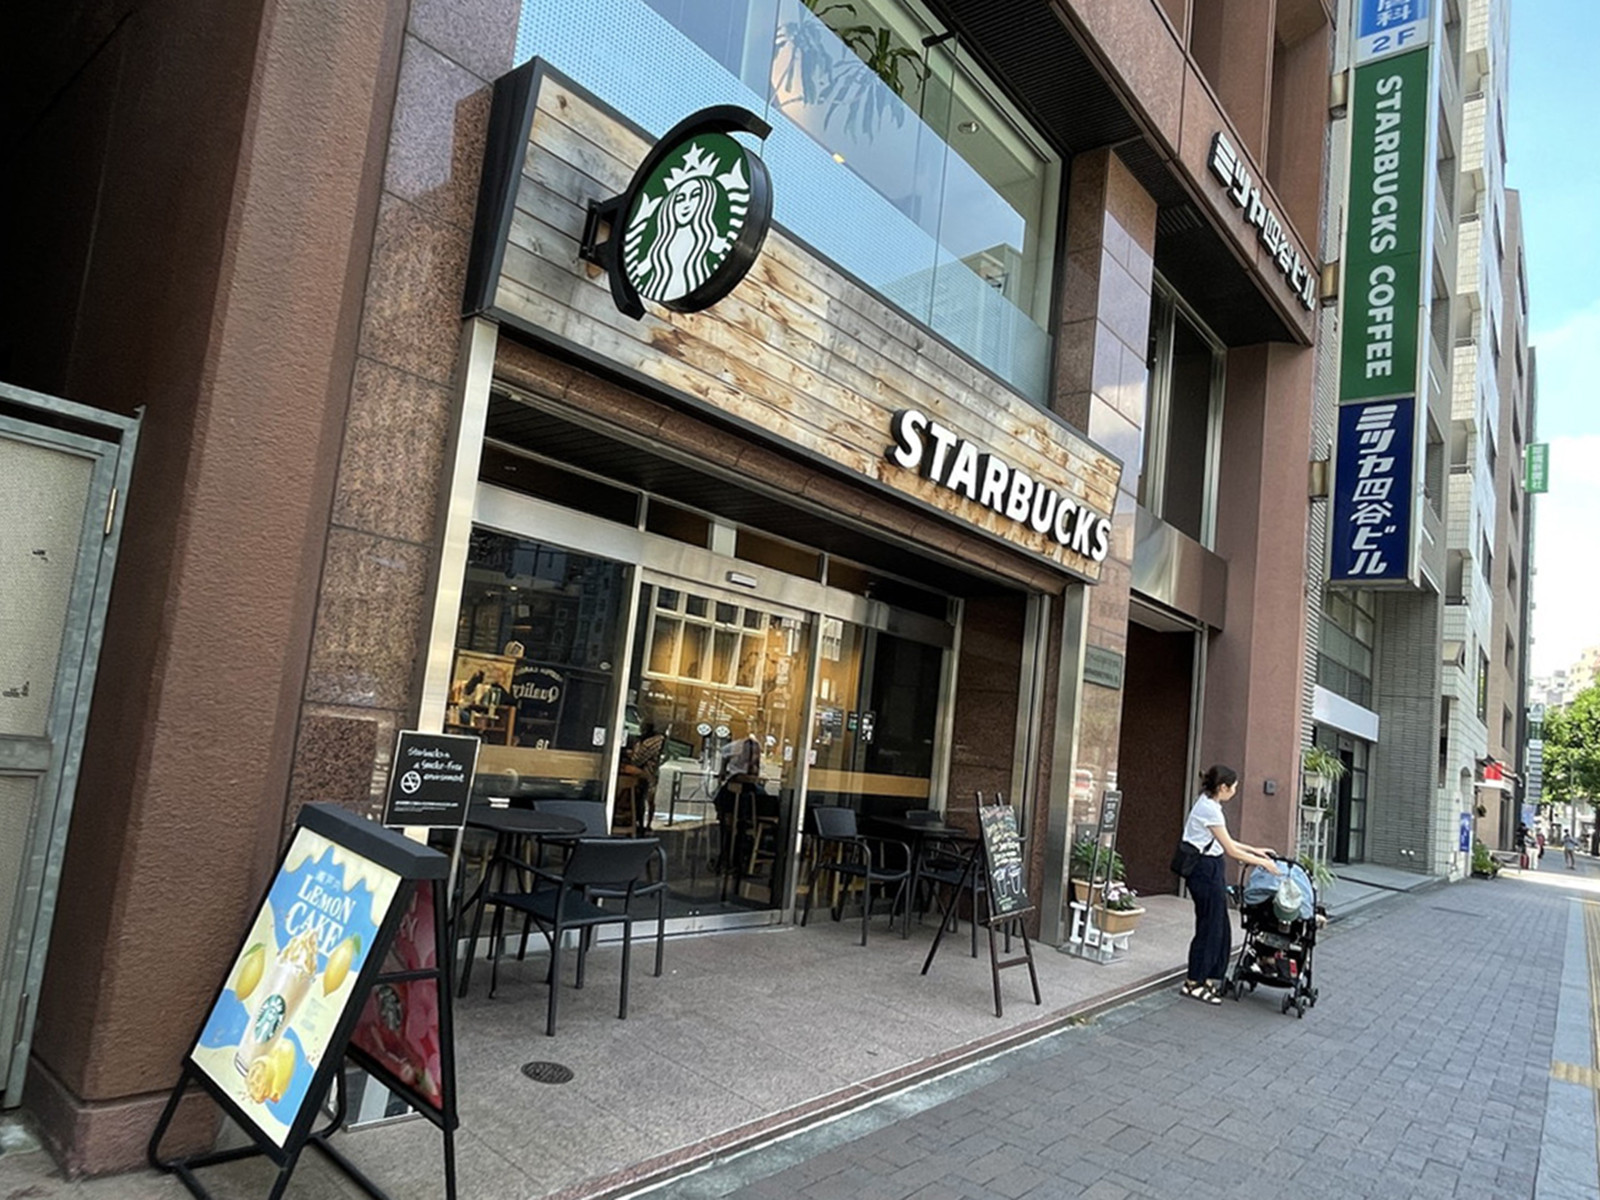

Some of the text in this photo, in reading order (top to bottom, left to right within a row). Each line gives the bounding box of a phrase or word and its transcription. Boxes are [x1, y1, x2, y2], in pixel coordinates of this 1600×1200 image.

[1372, 26, 1416, 53] 2F
[1211, 131, 1316, 312] ミツヤ四谷ビル
[1365, 74, 1403, 379] STARBUCKS COFFEE
[893, 409, 1112, 562] STARBUCKS
[1347, 404, 1398, 575] ミツヤ四谷ビル
[285, 900, 344, 958] CAKE
[297, 873, 357, 926] LEMON
